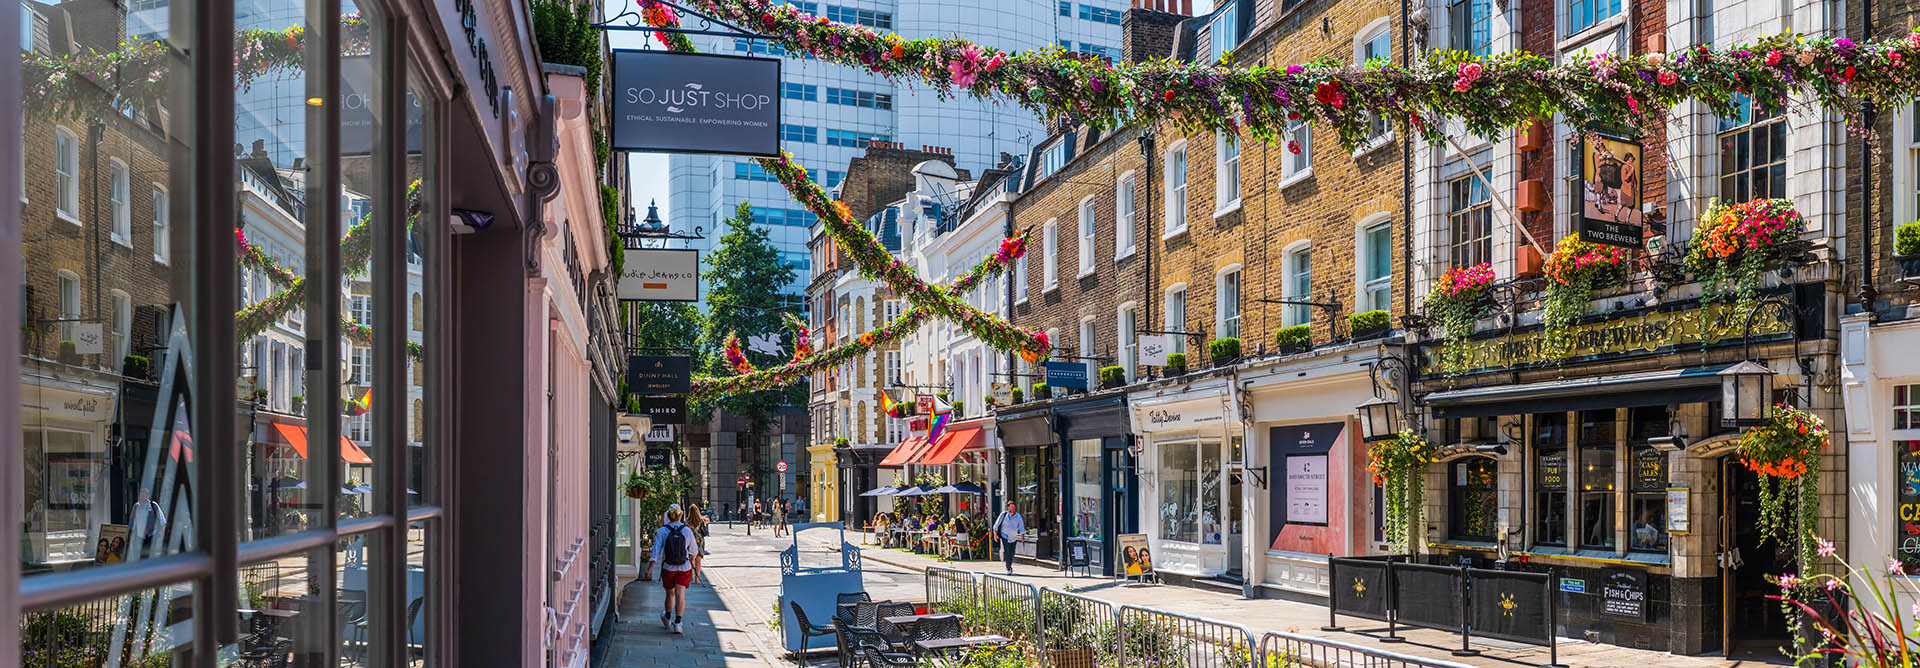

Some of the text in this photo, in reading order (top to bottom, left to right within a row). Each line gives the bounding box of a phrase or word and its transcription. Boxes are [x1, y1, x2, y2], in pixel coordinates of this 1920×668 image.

[627, 87, 770, 110] SO JUST SHOP
[699, 118, 741, 126] EMPOWERING
[1605, 224, 1619, 232] THE
[1587, 230, 1605, 239] TWO
[622, 269, 646, 279] udie
[1576, 321, 1666, 350] BREWERS
[1604, 587, 1620, 598] FISH
[1625, 589, 1643, 601] CHIPS
